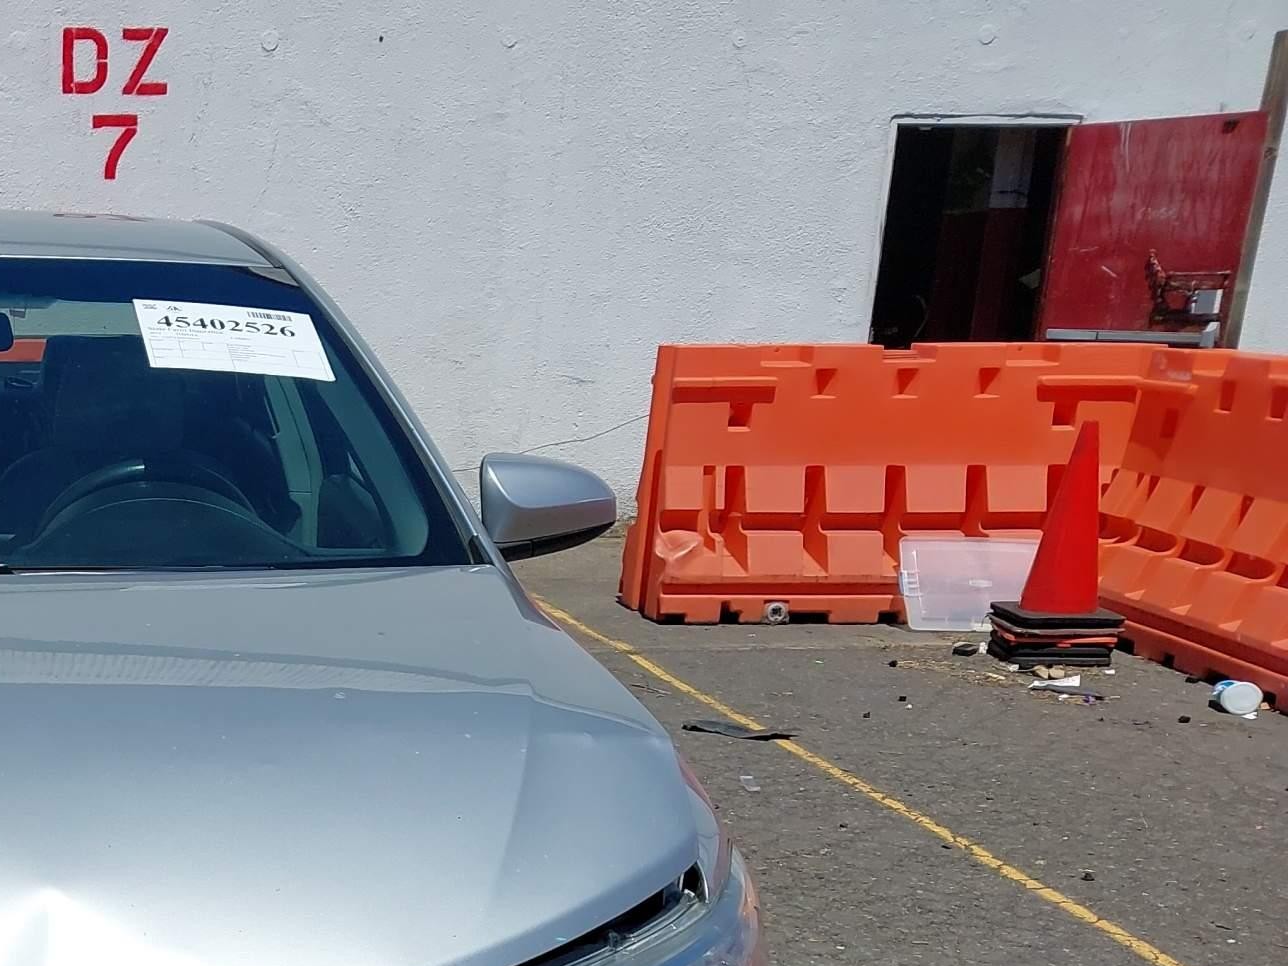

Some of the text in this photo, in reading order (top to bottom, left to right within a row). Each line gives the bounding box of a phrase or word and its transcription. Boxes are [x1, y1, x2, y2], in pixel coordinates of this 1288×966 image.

[62, 27, 169, 95] DZ
[92, 114, 137, 180] 7
[157, 315, 296, 338] 45402526
